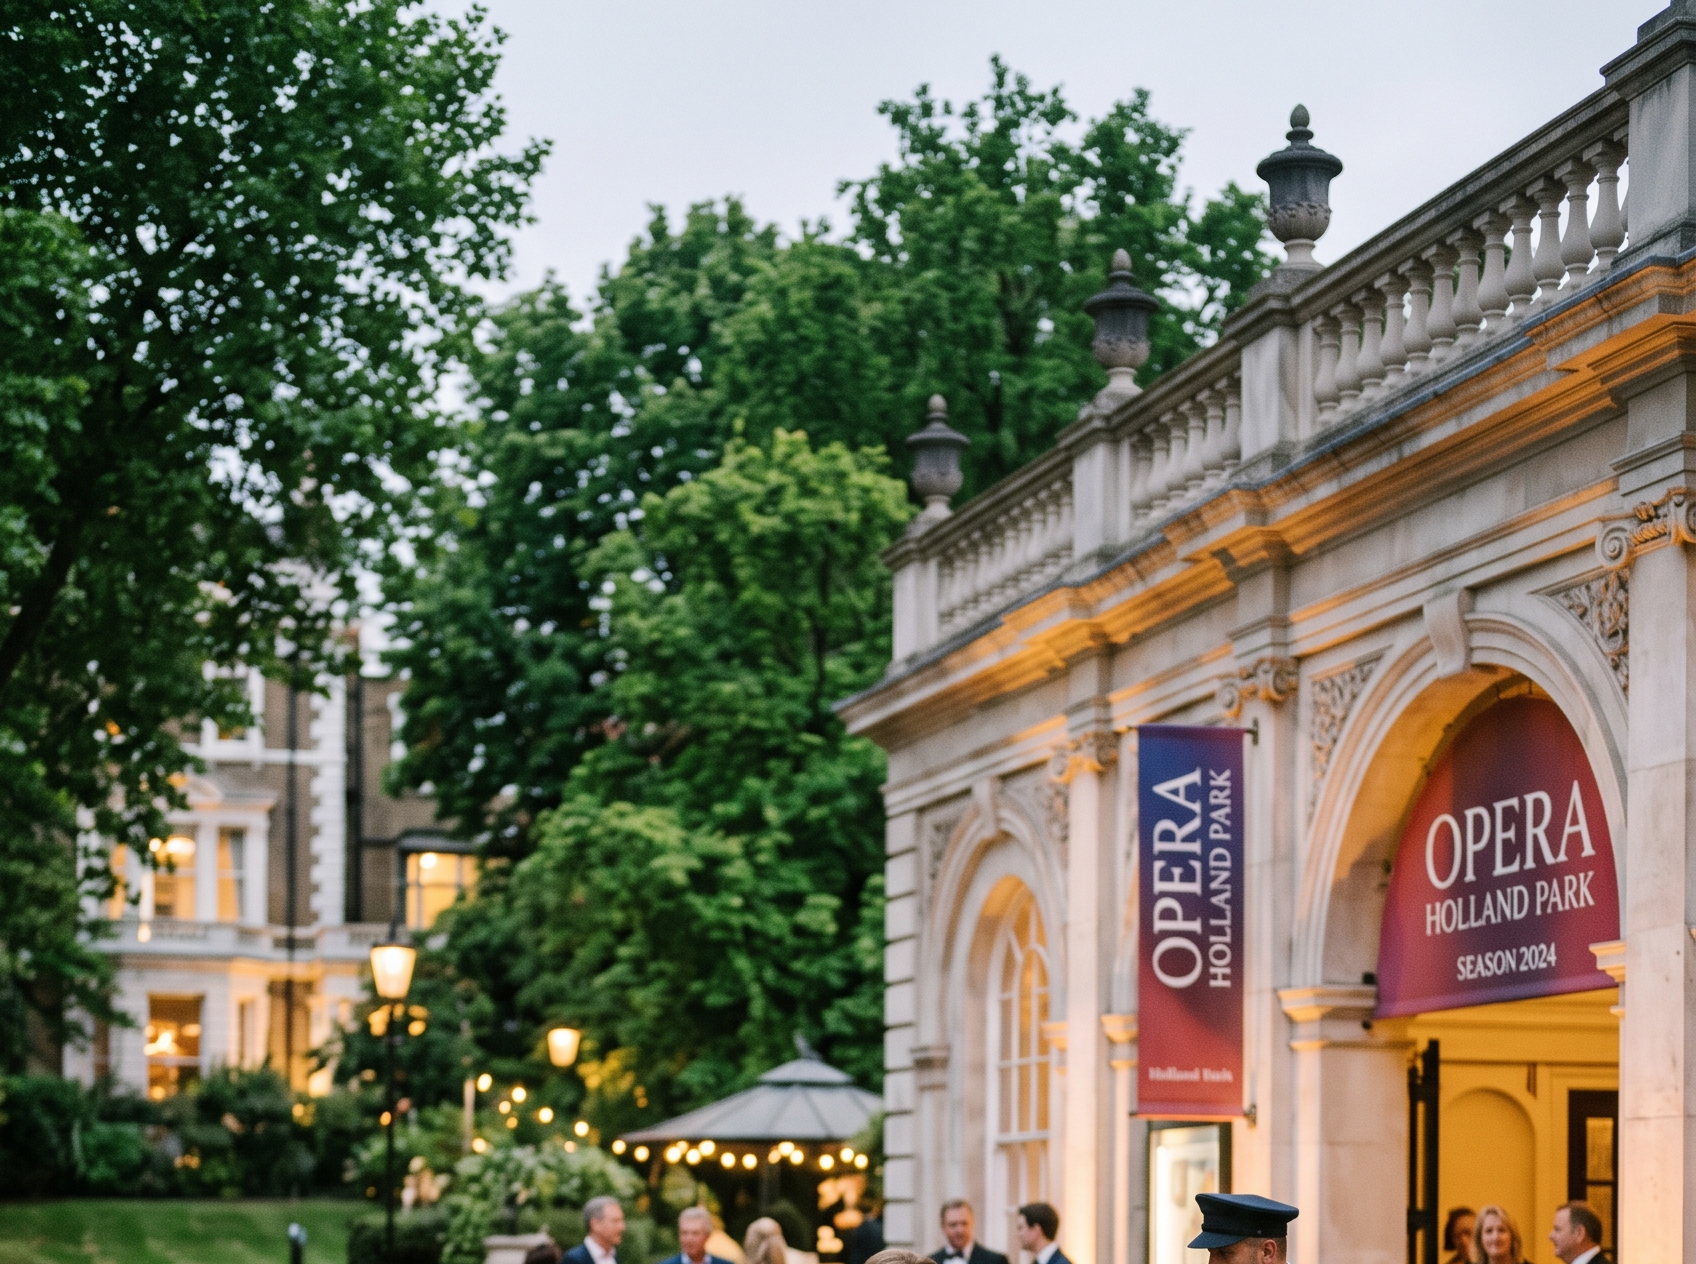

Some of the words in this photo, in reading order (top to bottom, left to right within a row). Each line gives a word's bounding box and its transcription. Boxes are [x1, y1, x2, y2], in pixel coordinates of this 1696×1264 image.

[1208, 768, 1232, 840] PARK
[1425, 780, 1596, 889] OPERA
[1152, 767, 1203, 989] OPERA
[1208, 846, 1232, 988] HOLLAND
[1425, 885, 1529, 936] HOLLAND
[1535, 871, 1595, 915] PARK
[1456, 949, 1517, 980] SEASON
[1519, 942, 1556, 971] 2024
